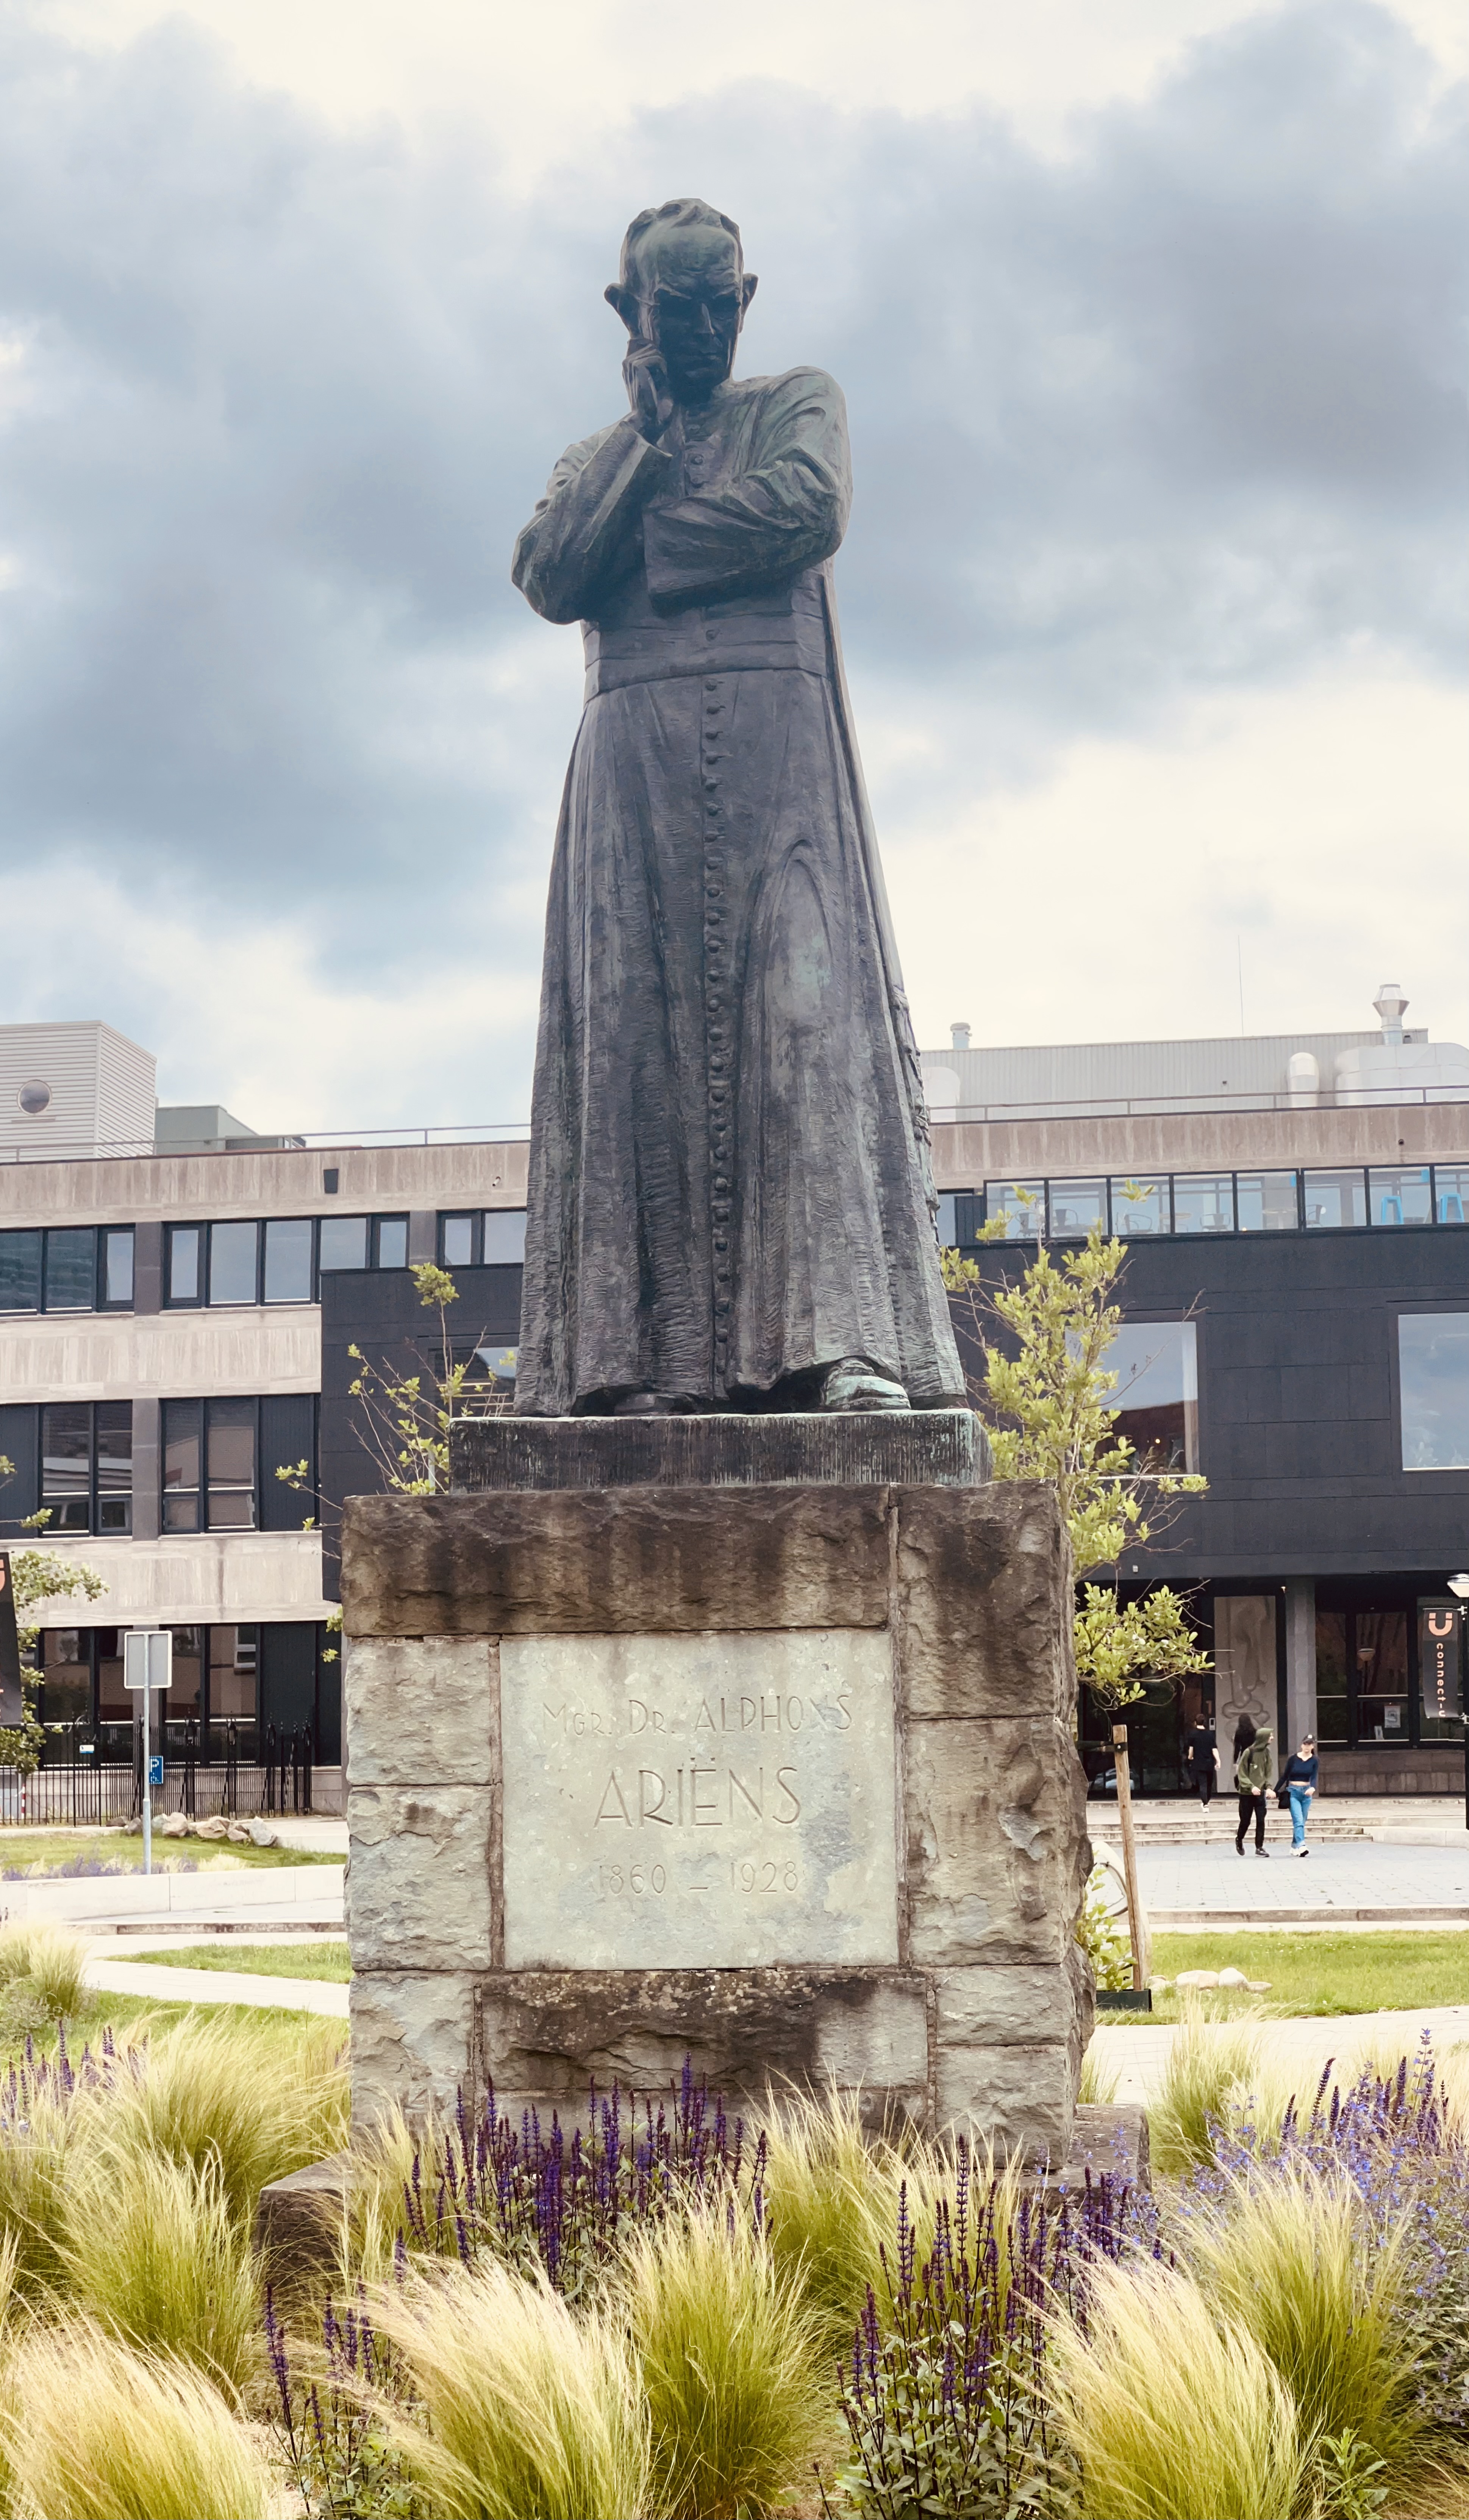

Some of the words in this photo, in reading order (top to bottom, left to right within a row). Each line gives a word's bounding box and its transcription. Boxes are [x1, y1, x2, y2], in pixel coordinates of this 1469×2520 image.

[694, 1695, 852, 1733] ALPHONS
[150, 1759, 159, 1772] P
[594, 1756, 802, 1828] ARIËNS
[597, 1864, 667, 1895] 1860
[730, 1861, 799, 1893] 1928
